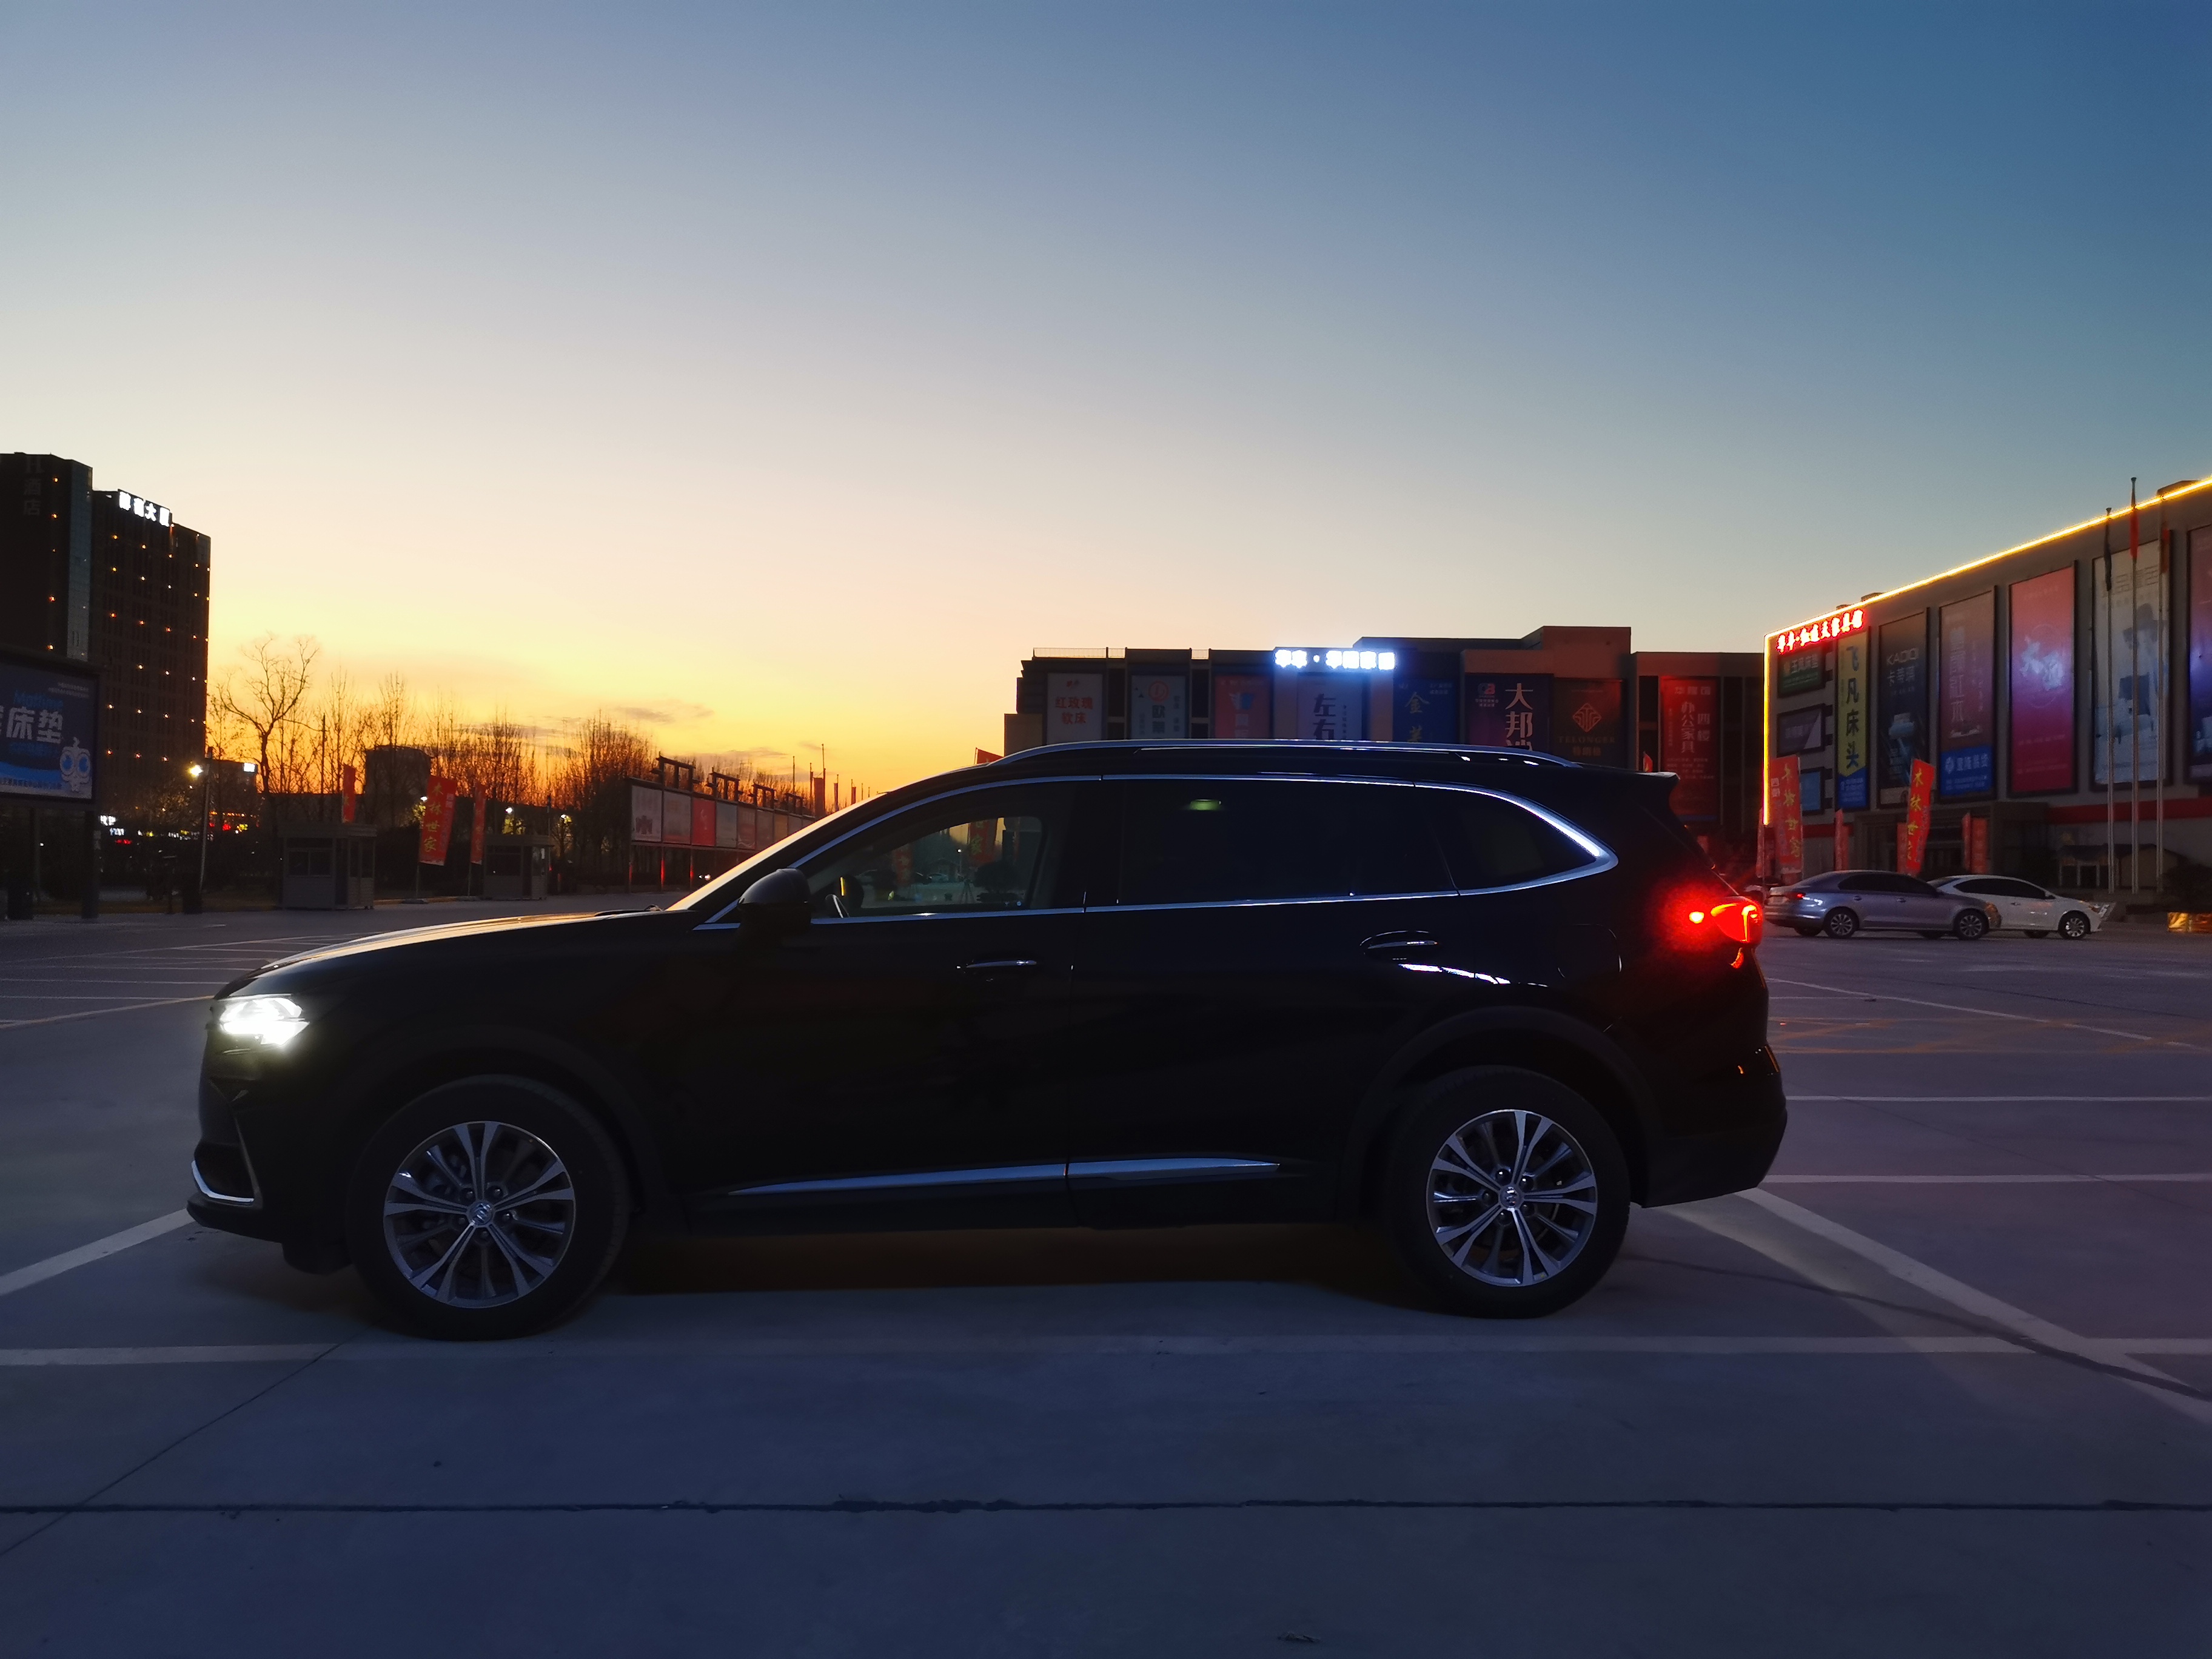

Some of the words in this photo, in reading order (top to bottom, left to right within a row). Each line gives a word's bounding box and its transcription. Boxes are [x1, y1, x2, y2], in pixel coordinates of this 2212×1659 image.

[24, 478, 42, 516] 酒店
[0, 705, 63, 744] 床垫
[1313, 694, 1336, 740] 左右
[1681, 702, 1695, 753] 办公家具
